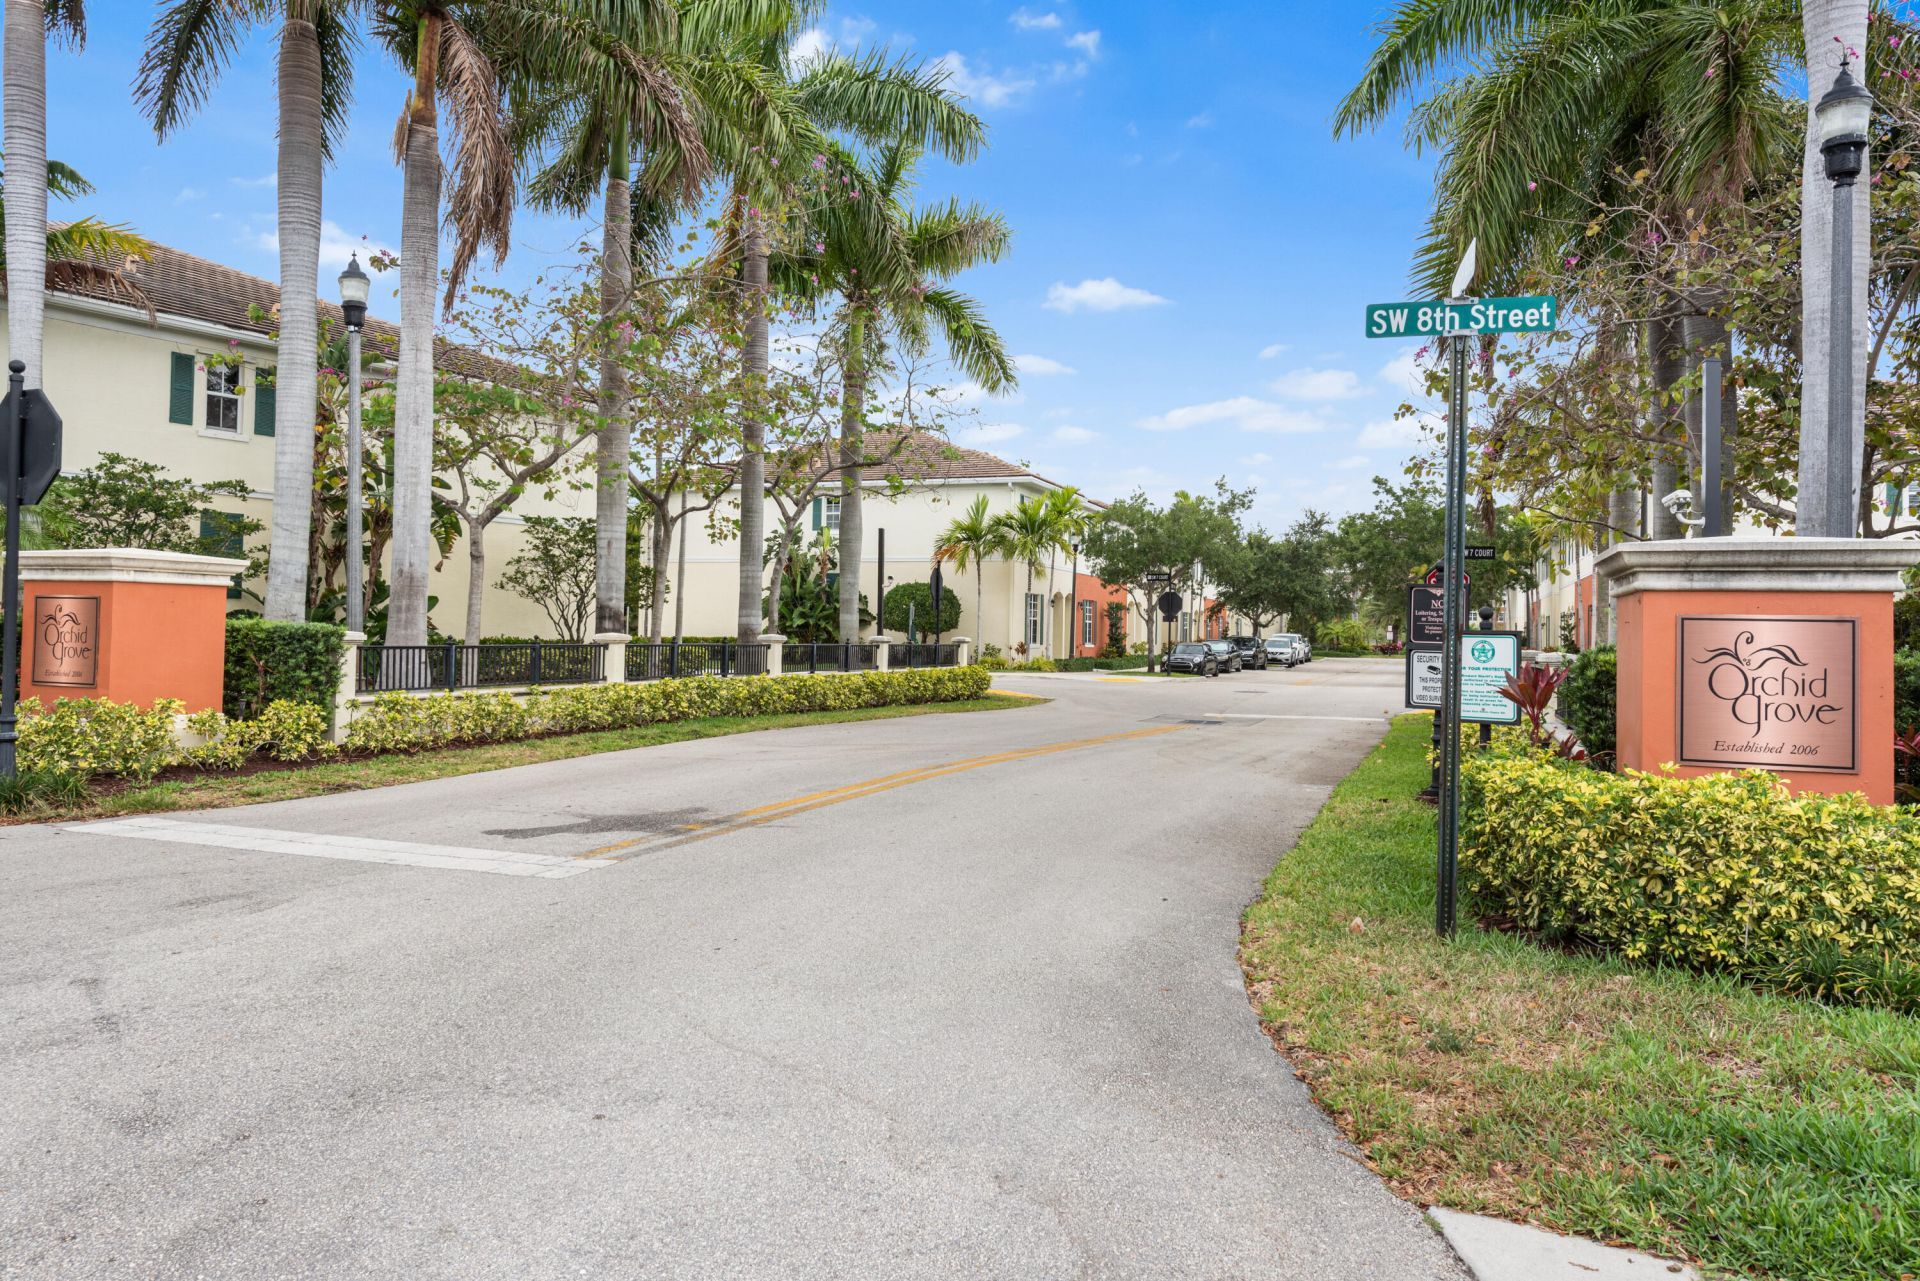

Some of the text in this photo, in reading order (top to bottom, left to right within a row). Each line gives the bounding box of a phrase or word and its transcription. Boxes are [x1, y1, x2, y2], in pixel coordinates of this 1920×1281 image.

[1372, 301, 1551, 334] SW 8th Street
[1469, 549, 1474, 557] 7
[1474, 549, 1494, 557] COURT
[45, 623, 88, 646] Orchid
[1416, 655, 1440, 663] SECURITY
[1708, 662, 1828, 700] Orchid
[1713, 740, 1821, 756] Established 2006
